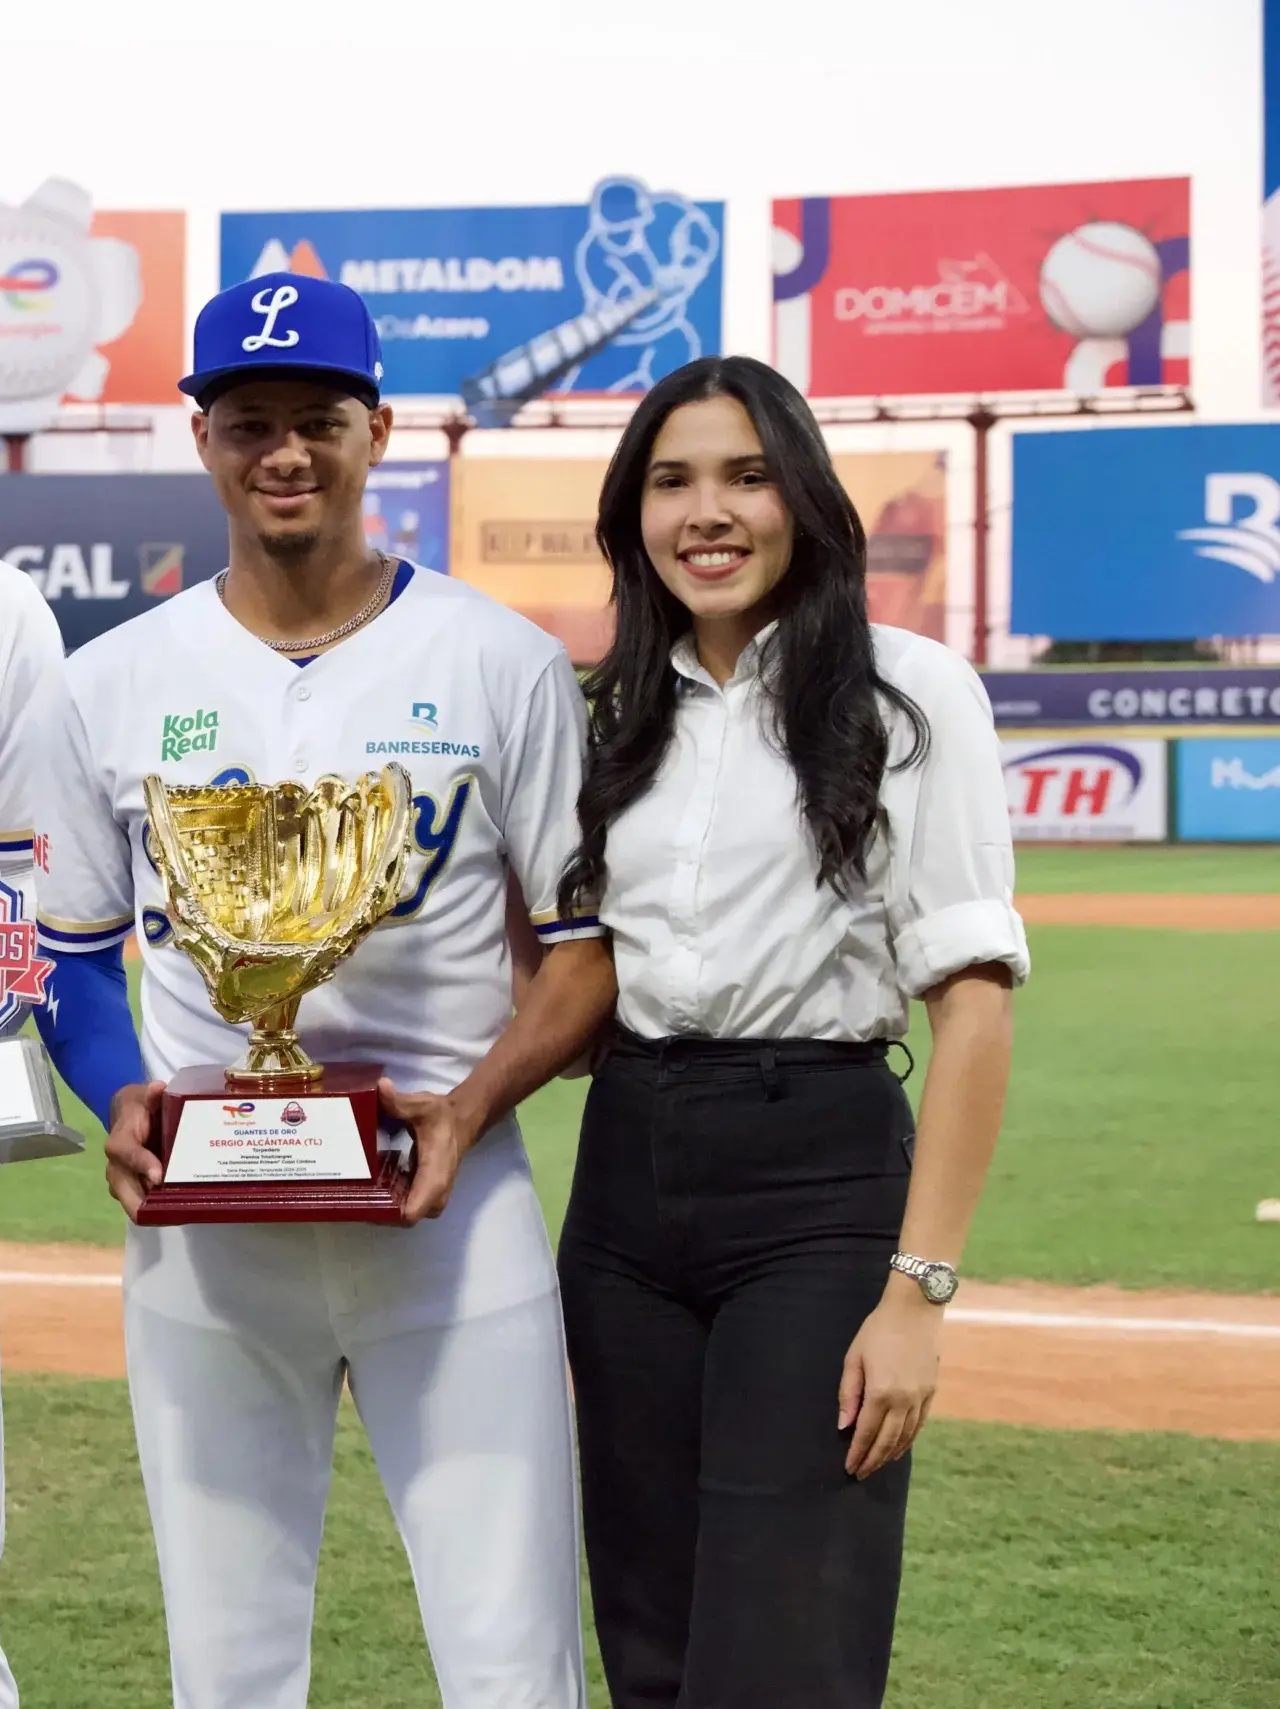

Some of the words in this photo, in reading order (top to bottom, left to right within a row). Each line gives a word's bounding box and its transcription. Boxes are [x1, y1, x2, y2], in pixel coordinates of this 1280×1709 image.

[341, 257, 563, 293] METALDOM
[242, 285, 299, 353] L
[164, 709, 219, 739] Kola
[161, 728, 217, 762] Real
[365, 740, 481, 759] BANRESERVAS
[1008, 768, 1114, 816] TH
[209, 1139, 244, 1147] SERGIO
[246, 1137, 301, 1147] ALCÁNTARA
[304, 1138, 323, 1146] (TL)
